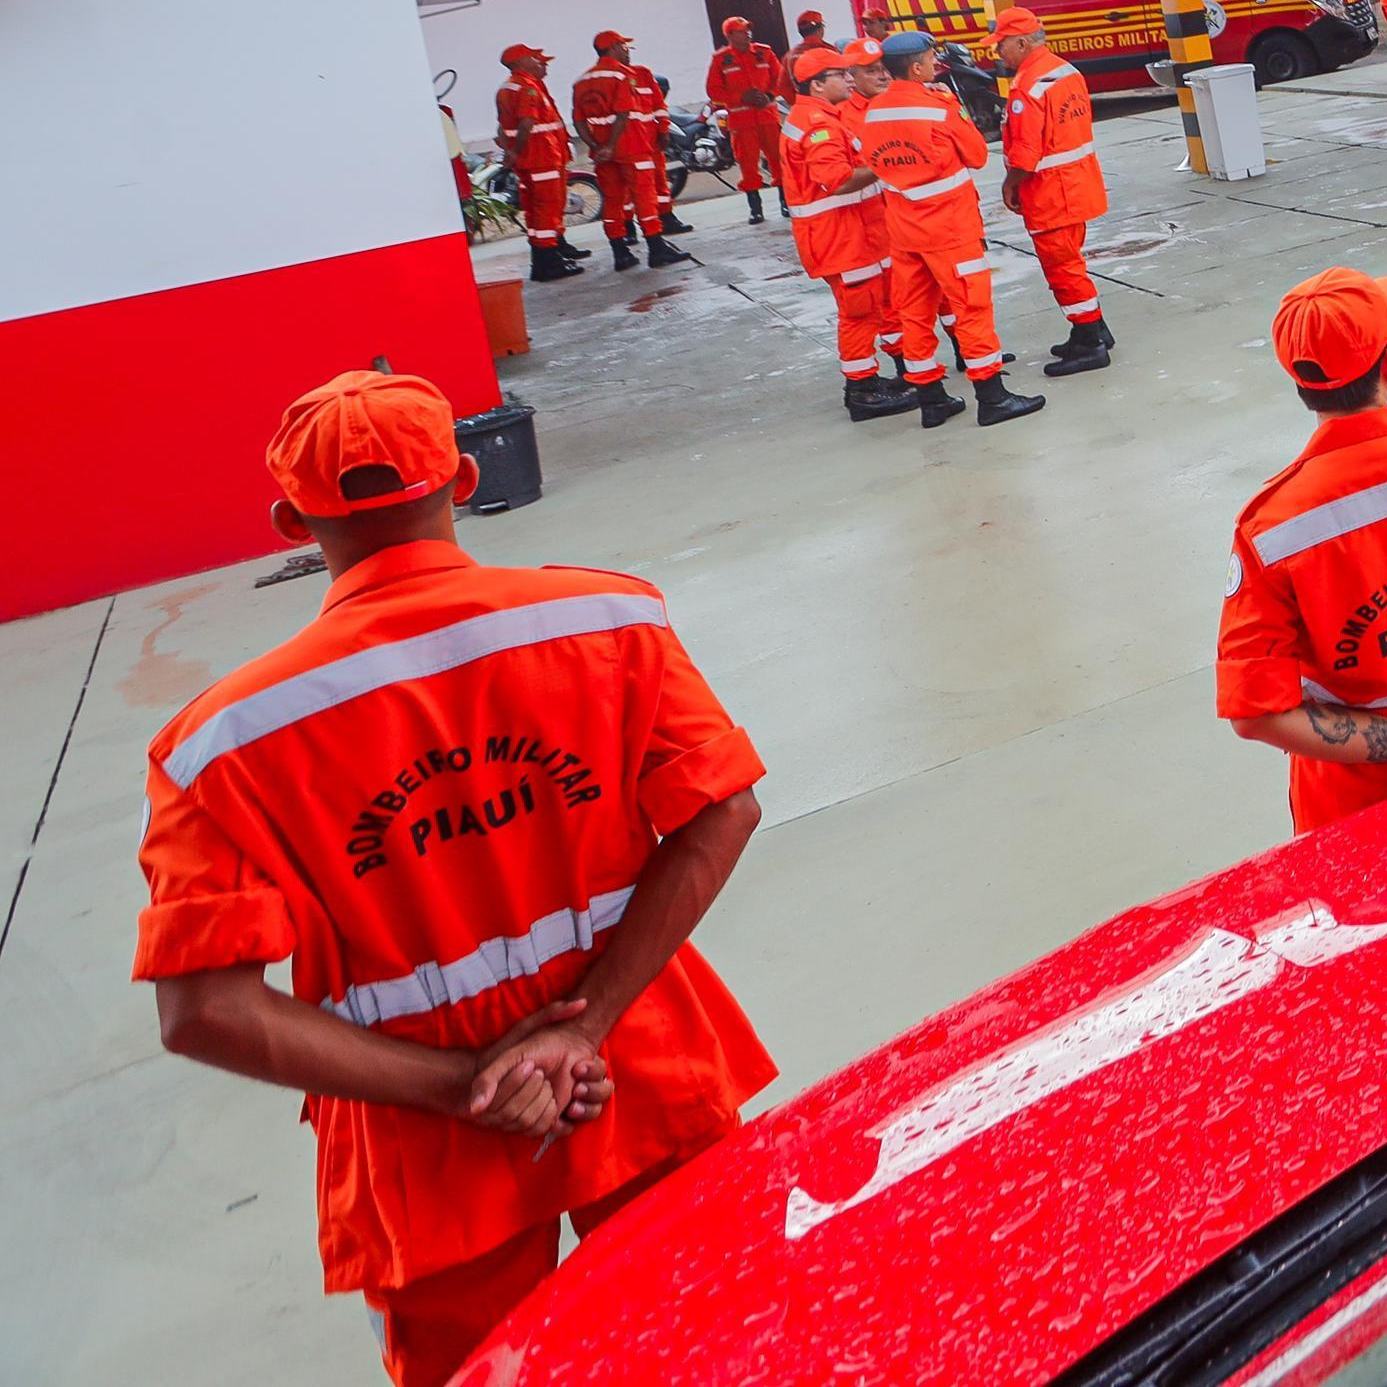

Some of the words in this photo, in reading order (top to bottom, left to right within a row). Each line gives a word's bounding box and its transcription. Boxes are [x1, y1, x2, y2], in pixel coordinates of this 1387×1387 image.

[1118, 29, 1169, 47] MILITA
[346, 748, 473, 880] BOMBEIRO
[485, 734, 602, 810] MILITAR
[410, 774, 535, 856] PIAUÍ
